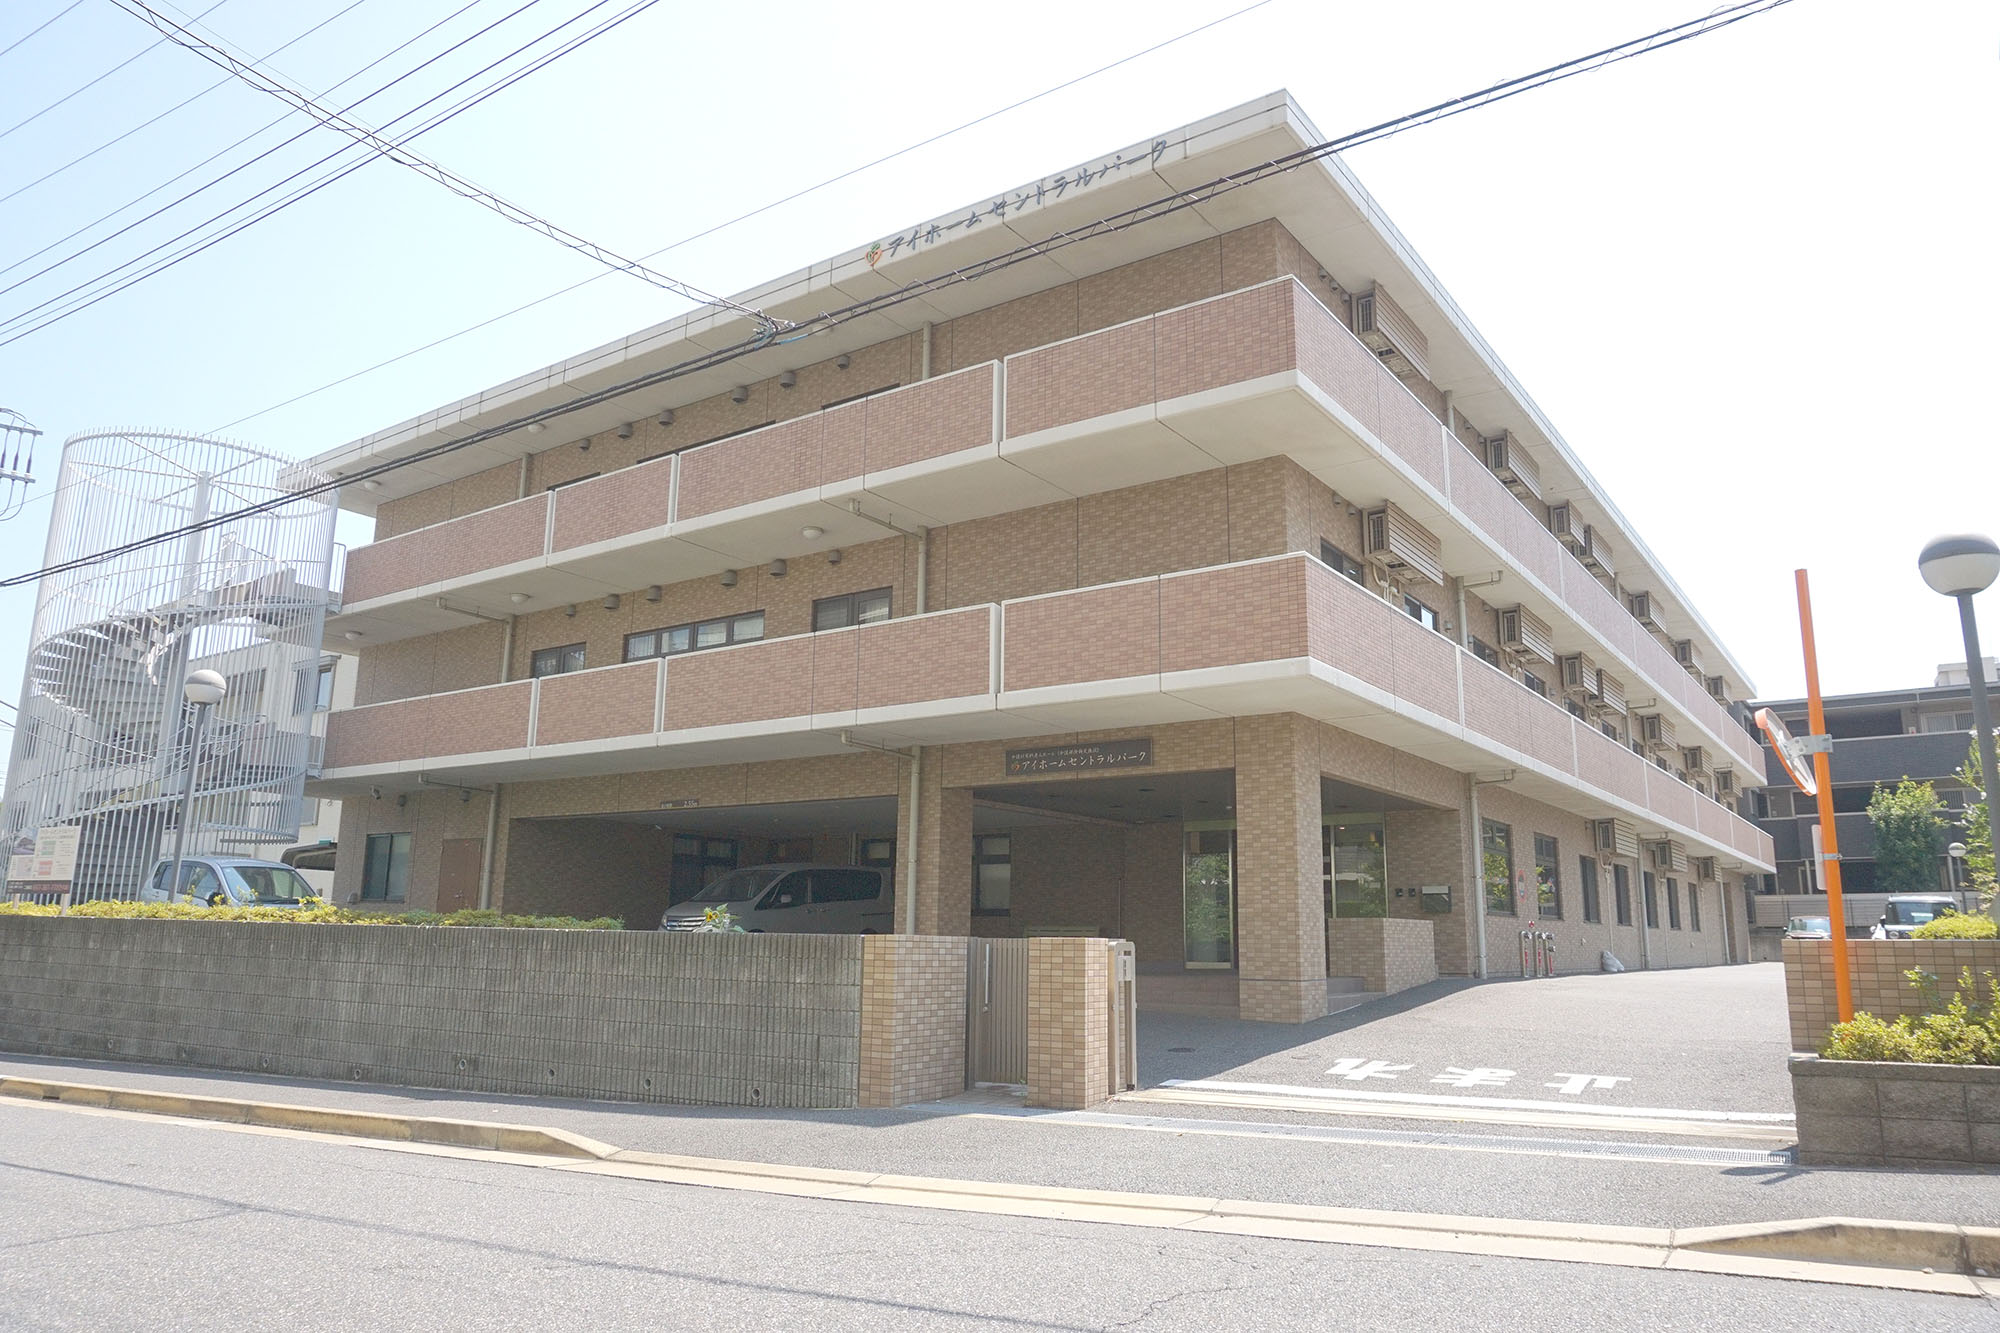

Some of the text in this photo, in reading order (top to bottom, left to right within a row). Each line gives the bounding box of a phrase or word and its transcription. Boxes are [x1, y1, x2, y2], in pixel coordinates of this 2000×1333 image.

[888, 140, 1168, 257] アイホームセントラルパーク
[1022, 751, 1146, 771] アイホームセントラルパーク
[1325, 1057, 1632, 1095] 止まれ
